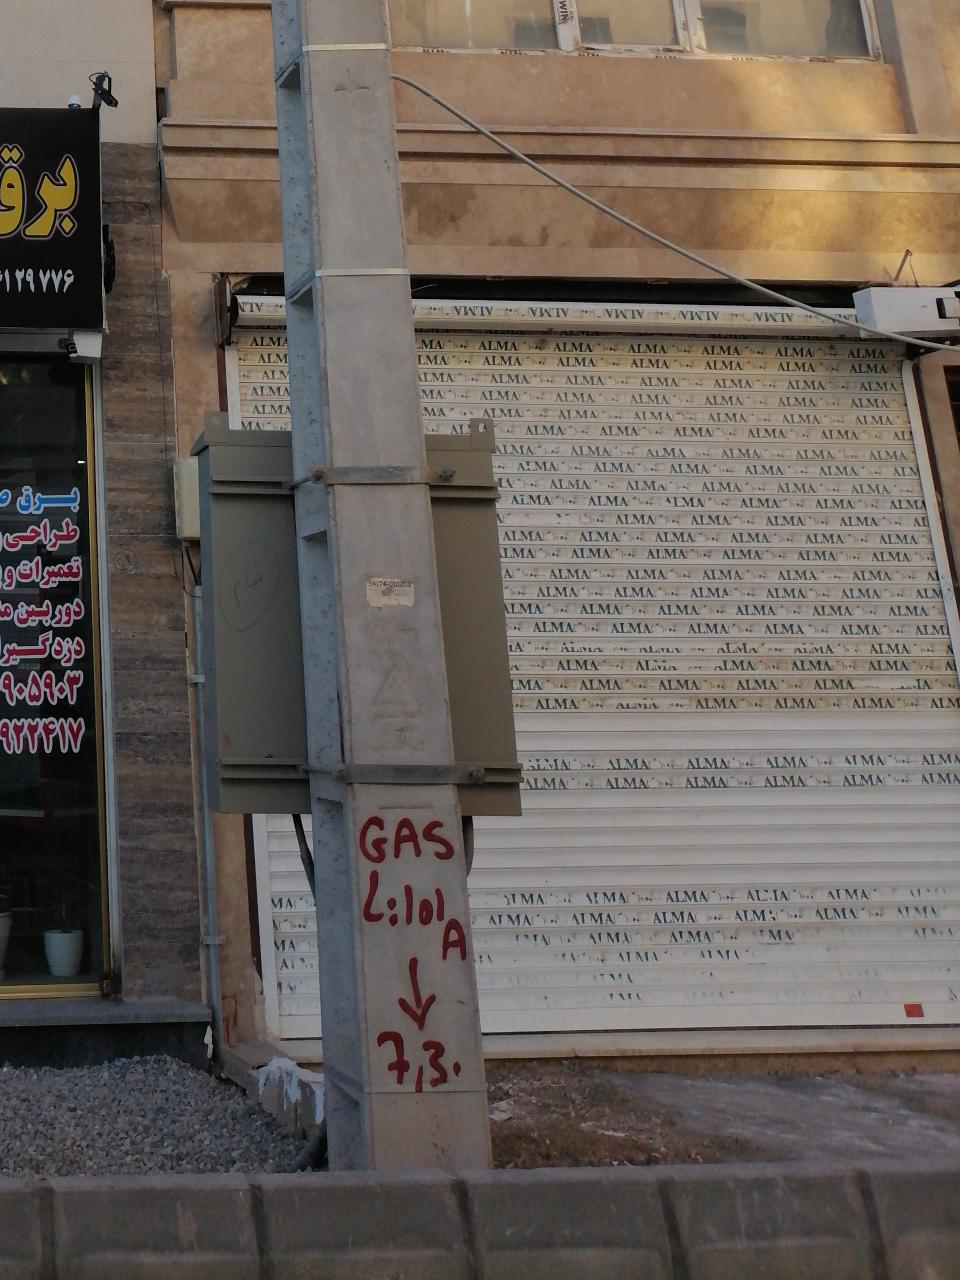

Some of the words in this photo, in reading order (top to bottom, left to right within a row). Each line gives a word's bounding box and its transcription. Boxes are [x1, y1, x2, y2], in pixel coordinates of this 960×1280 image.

[17, 486, 80, 514] برق
[3, 518, 80, 551] طراحی
[3, 566, 16, 591] و
[16, 556, 81, 589] تعمیرات
[359, 816, 454, 863] GAS
[442, 919, 467, 960] A
